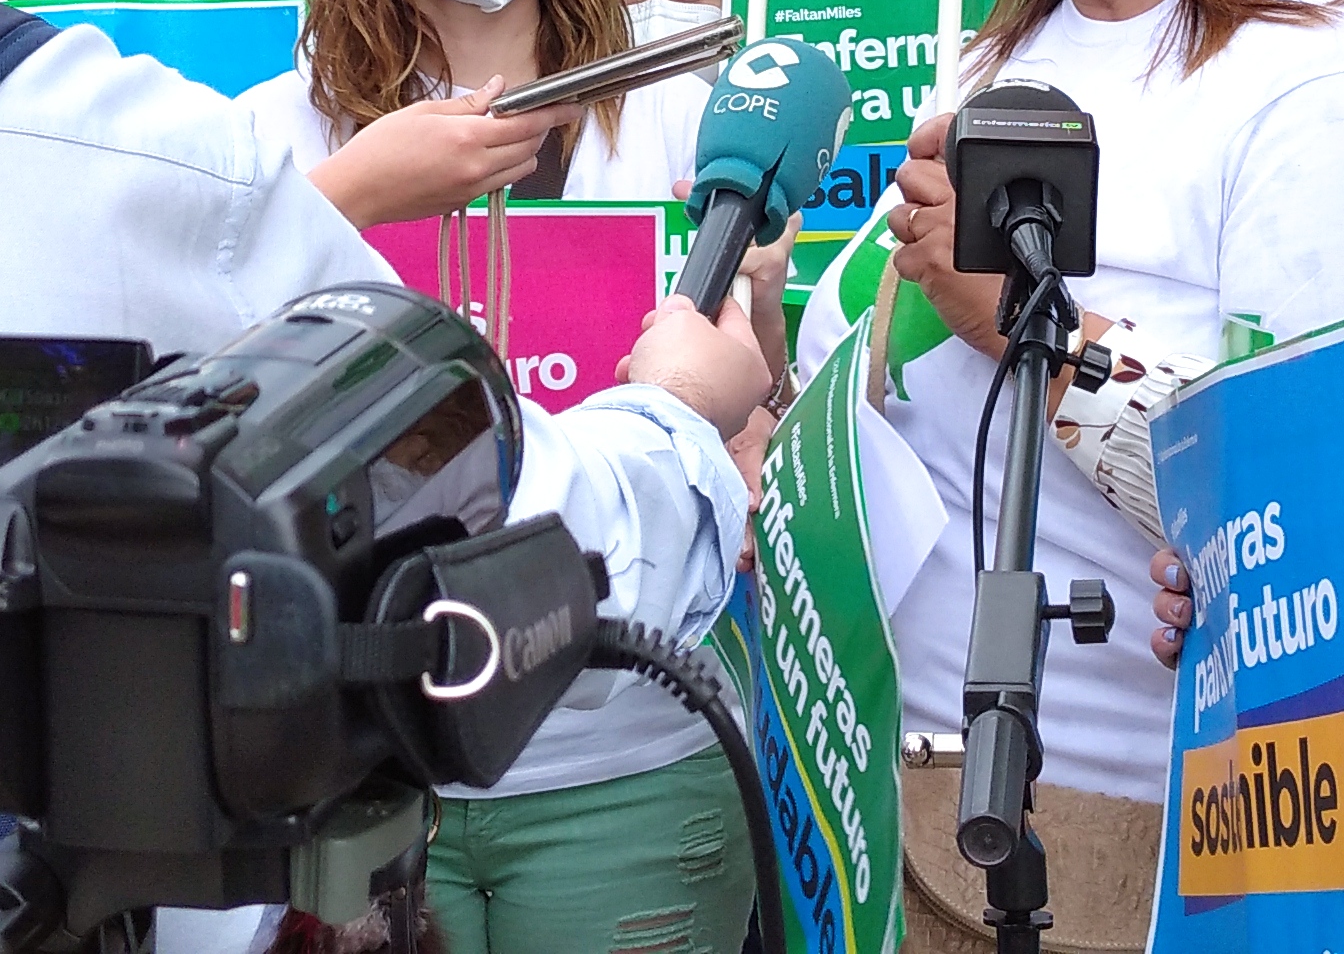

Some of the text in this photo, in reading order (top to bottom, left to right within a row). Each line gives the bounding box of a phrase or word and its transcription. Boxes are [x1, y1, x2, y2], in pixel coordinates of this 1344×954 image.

[774, 5, 862, 23] #FaltanMiles
[713, 92, 780, 121] COPE
[851, 87, 892, 122] ra
[791, 421, 808, 507] #FaltanMiles
[503, 604, 572, 683] Canon
[758, 442, 872, 774] Enfermeras
[1229, 577, 1338, 673] futuro
[775, 623, 810, 719] un
[805, 699, 871, 905] futuro
